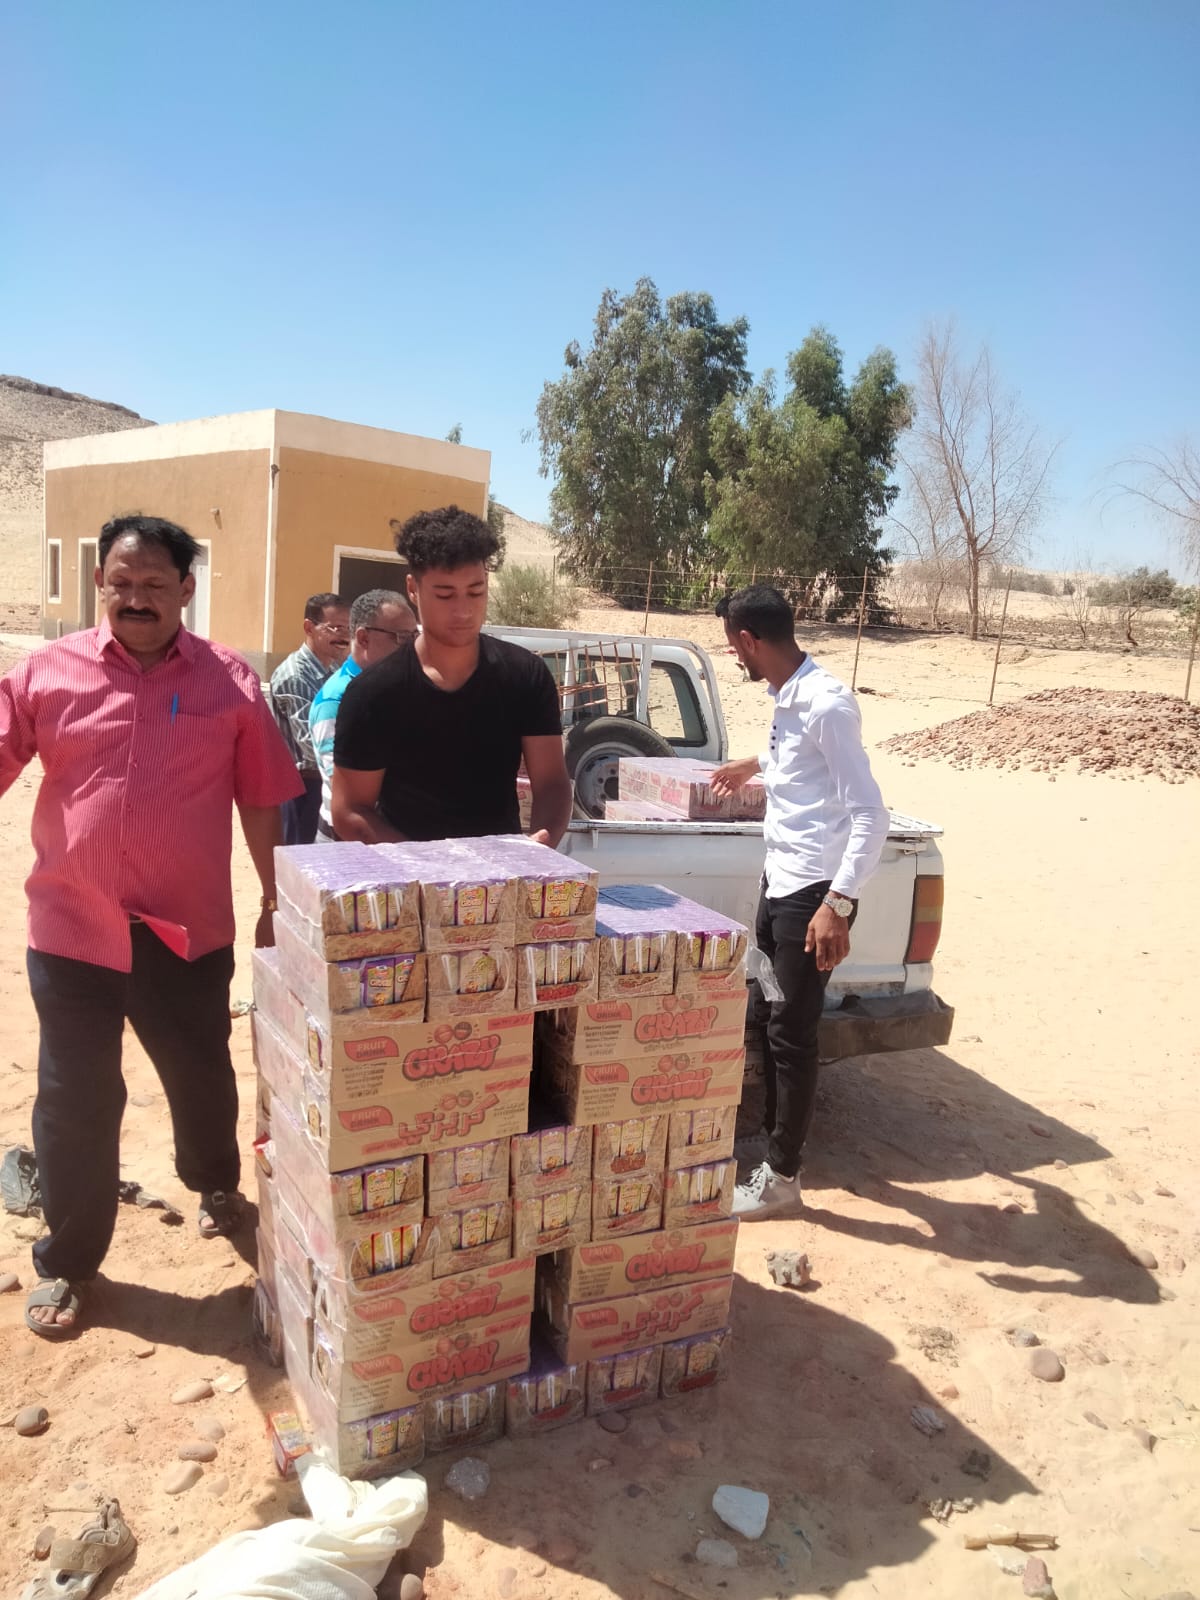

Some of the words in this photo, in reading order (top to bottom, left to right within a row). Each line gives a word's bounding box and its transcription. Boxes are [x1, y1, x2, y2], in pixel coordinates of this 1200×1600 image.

[635, 1005, 719, 1043] CRAZY
[357, 1040, 387, 1051] FRUIT
[403, 1034, 502, 1081] CRAZY
[631, 1066, 713, 1106] CRAZY
[351, 1109, 382, 1121] FRUIT
[399, 1093, 499, 1145] كريزي
[625, 1242, 706, 1283] CRAZY
[410, 1281, 503, 1335] CRAZY
[406, 1339, 500, 1393] CRAZY
